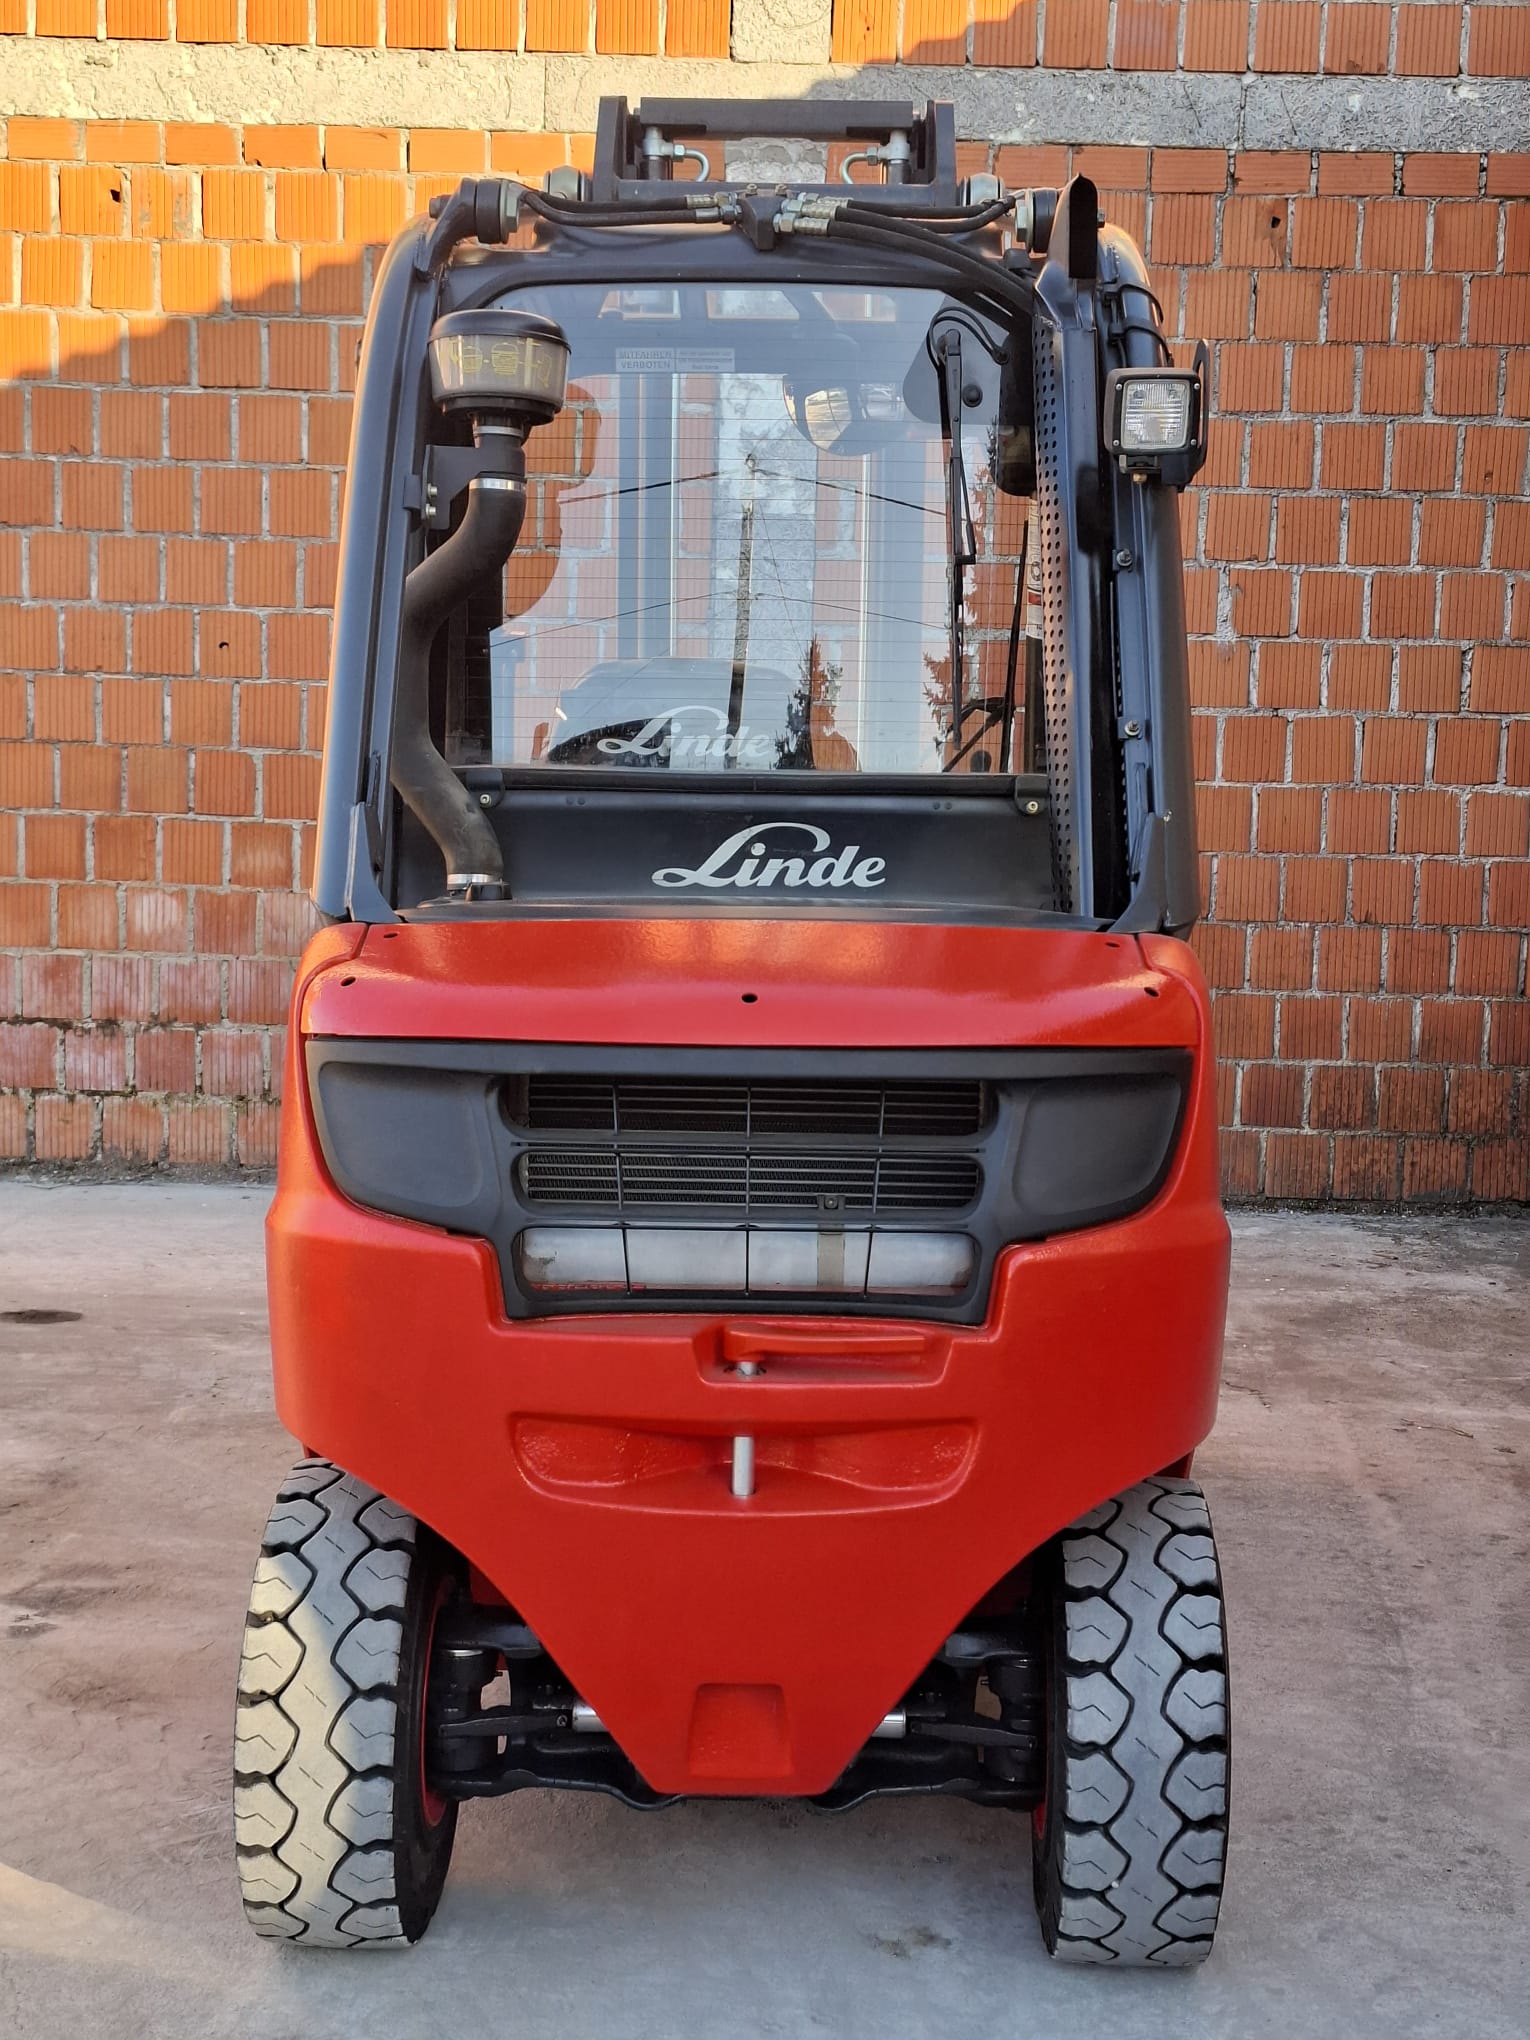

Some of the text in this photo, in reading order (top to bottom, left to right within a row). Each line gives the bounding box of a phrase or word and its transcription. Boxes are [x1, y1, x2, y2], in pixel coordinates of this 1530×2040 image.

[620, 360, 671, 369] VERBOTEN
[597, 705, 771, 756] Linde
[652, 822, 886, 888] Linde
